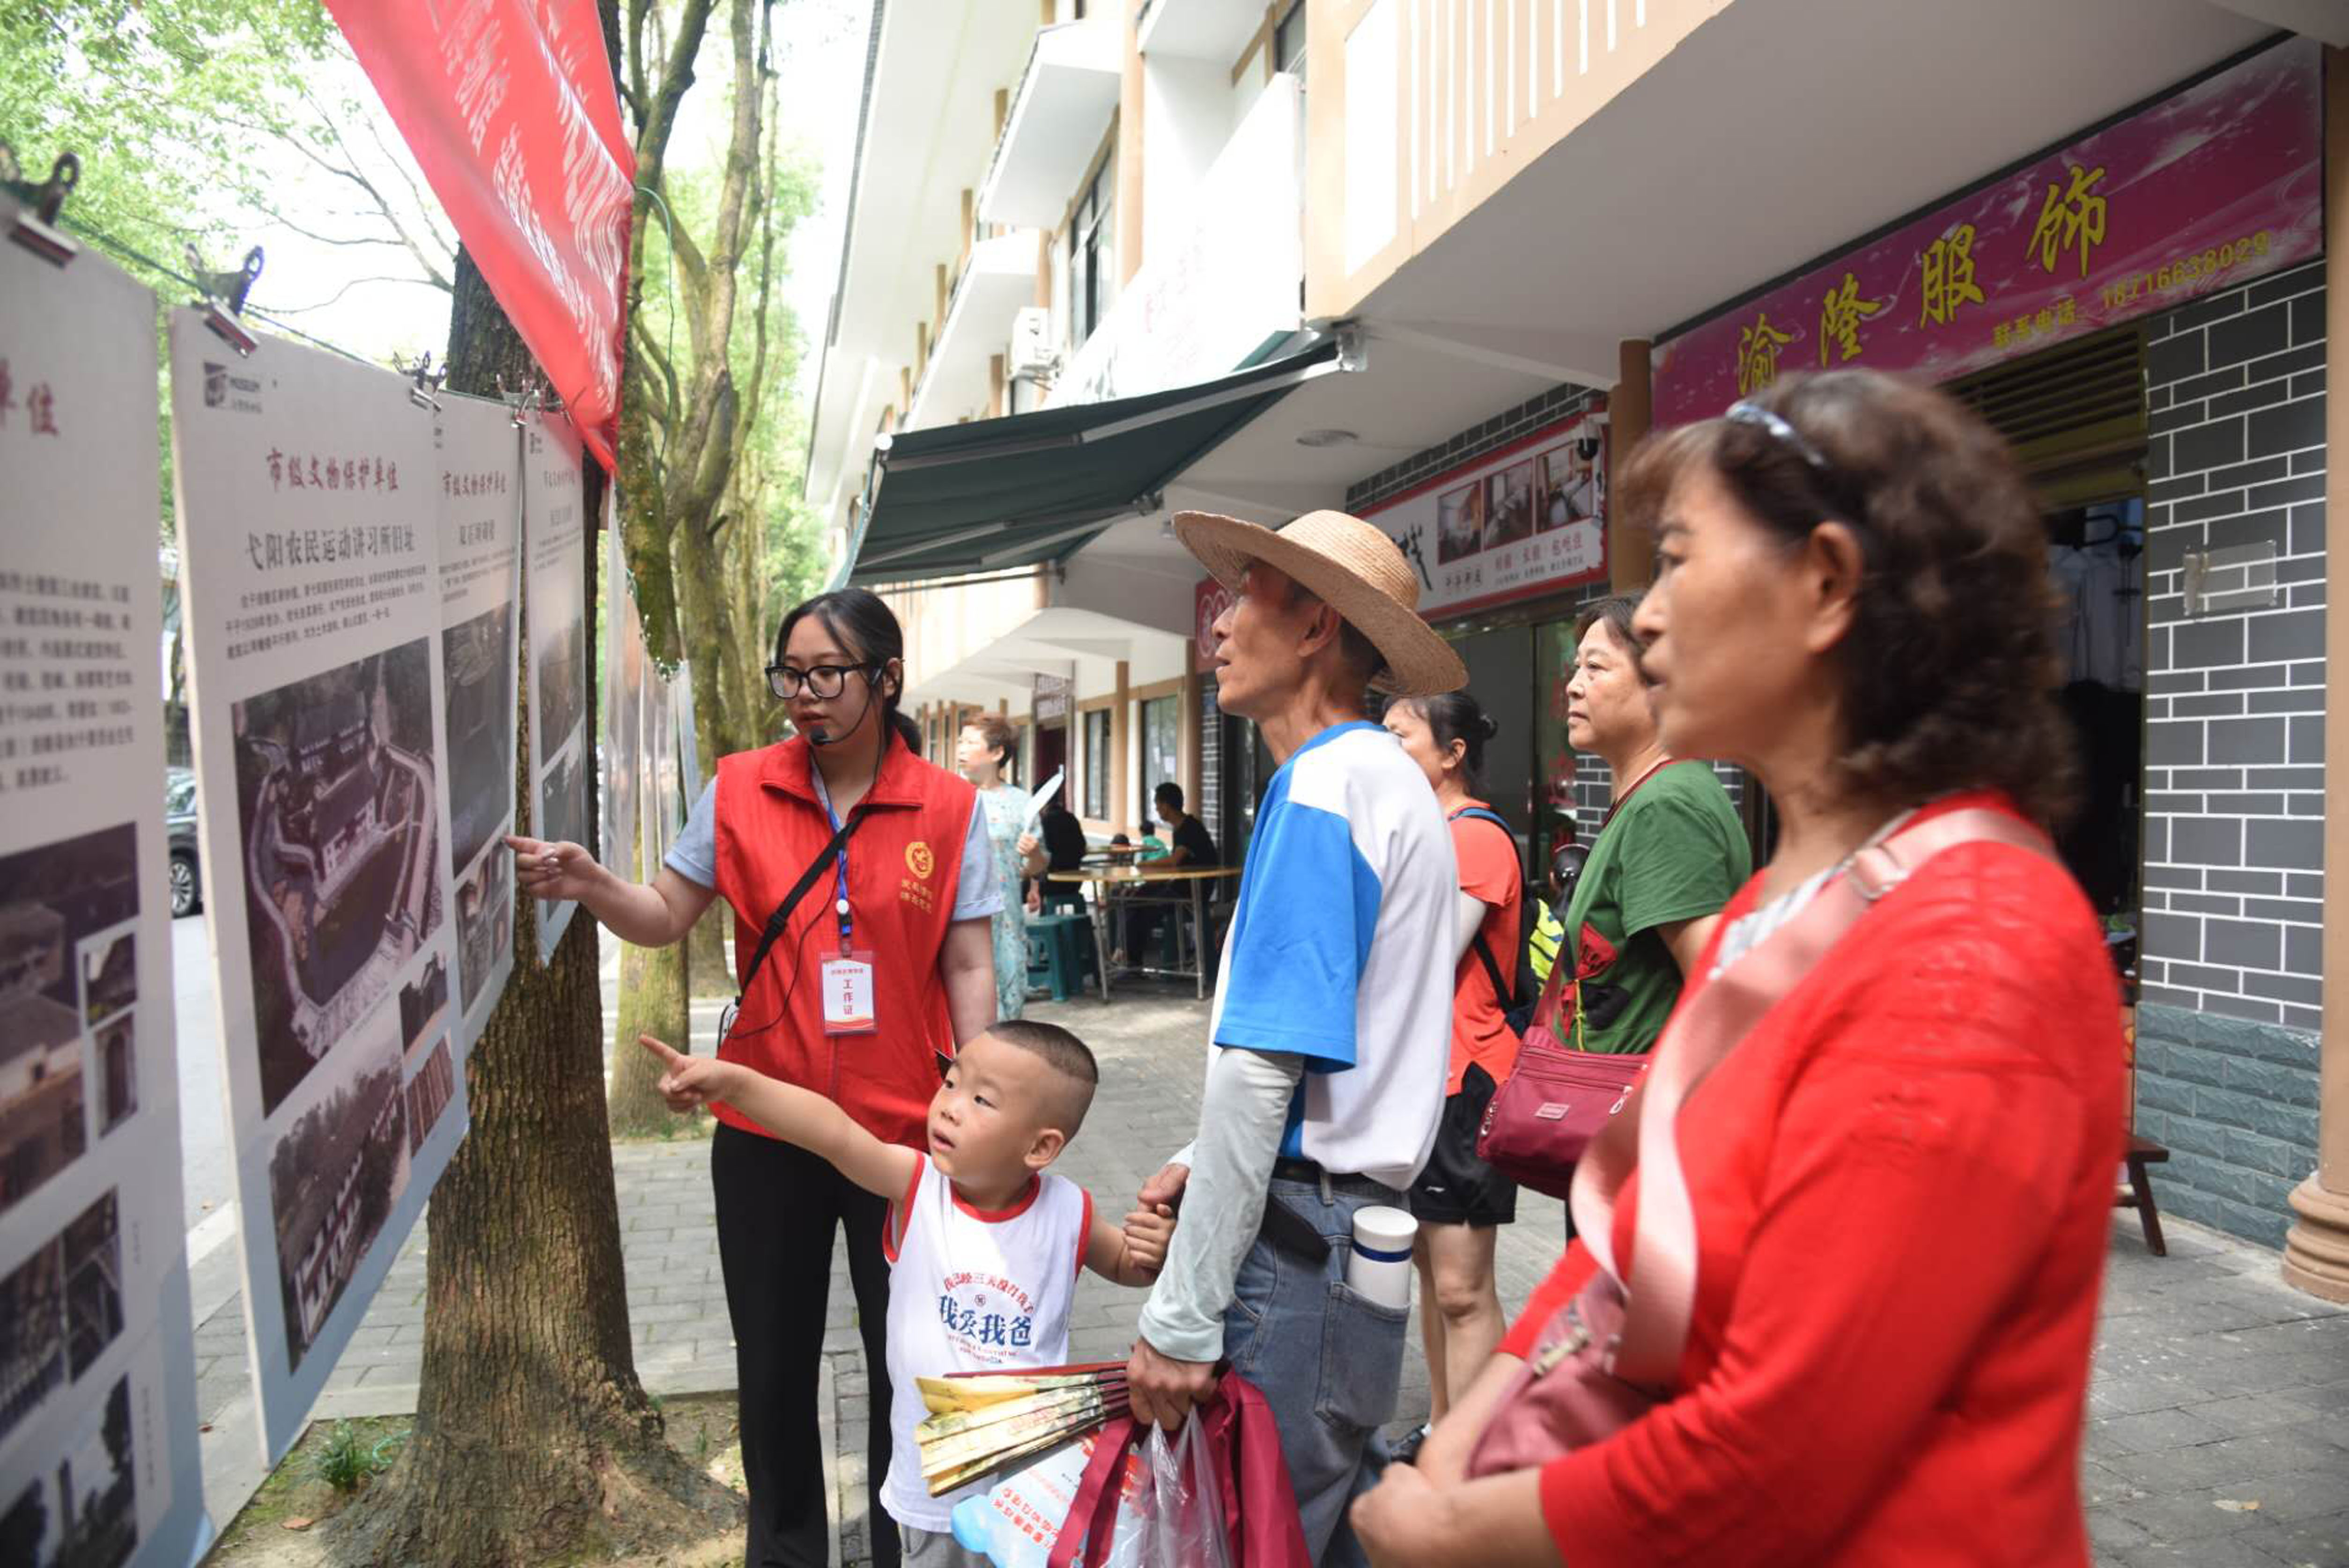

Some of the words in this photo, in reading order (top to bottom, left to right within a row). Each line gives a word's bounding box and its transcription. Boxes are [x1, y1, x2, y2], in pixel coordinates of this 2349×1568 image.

[1737, 164, 2106, 397] 渝隆服饰
[266, 446, 399, 492] 市级文物保护单位
[247, 525, 415, 571] 弋阳农民运动讲习所旧址
[843, 979, 853, 1016] 工作证
[939, 1294, 1032, 1347] 我爱我爸
